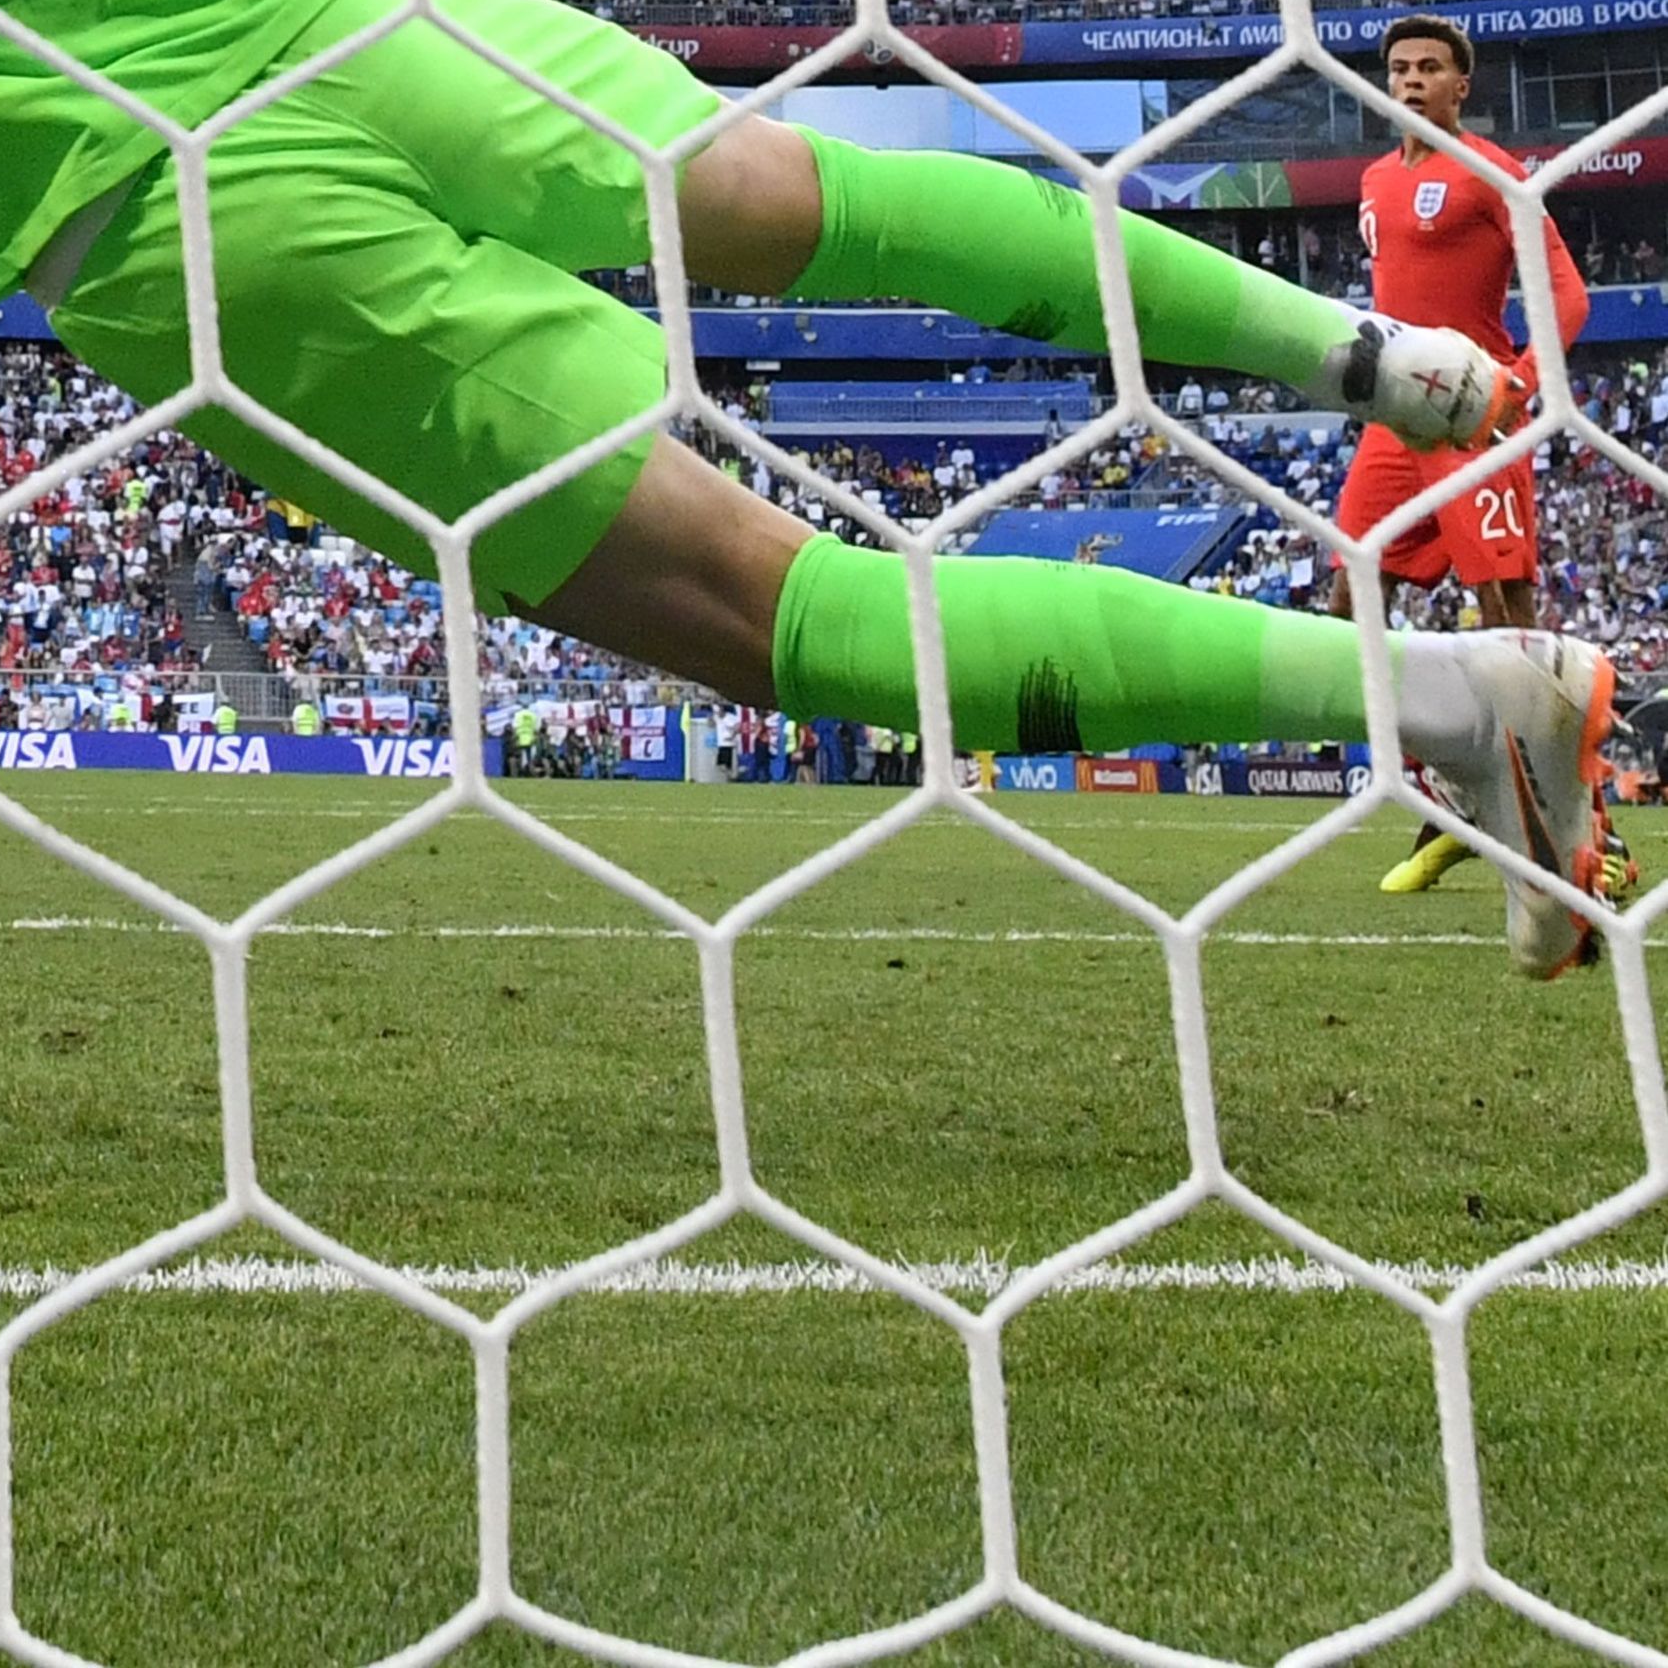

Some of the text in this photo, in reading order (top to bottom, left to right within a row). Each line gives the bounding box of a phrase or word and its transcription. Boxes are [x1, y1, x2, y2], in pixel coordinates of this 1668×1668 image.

[1476, 10, 1527, 34] FIFA
[1530, 4, 1585, 30] 2018
[1474, 487, 1525, 540] 20
[158, 734, 272, 774] VISA
[350, 737, 456, 777] VISA
[1248, 769, 1343, 794] QATAR AIRWAYS
